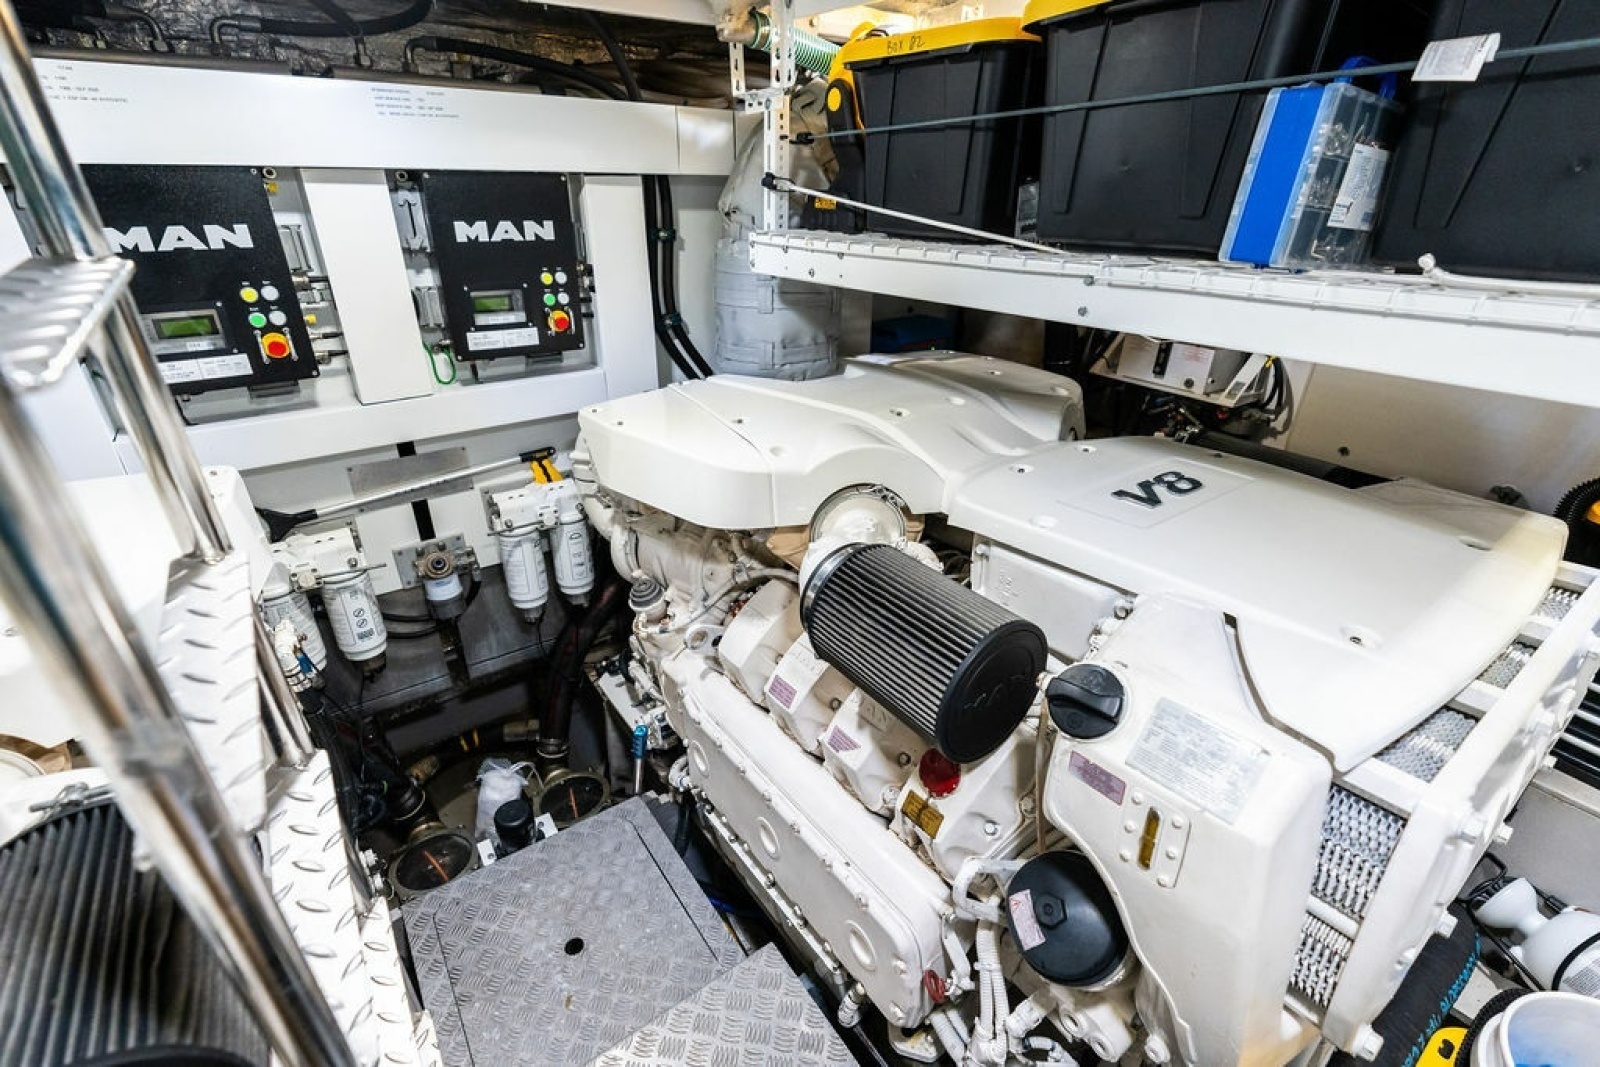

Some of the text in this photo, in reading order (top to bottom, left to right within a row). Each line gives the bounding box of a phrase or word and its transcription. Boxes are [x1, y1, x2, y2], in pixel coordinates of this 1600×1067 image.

[887, 40, 903, 54] BOX
[103, 223, 254, 253] MAN
[453, 220, 556, 243] MAN
[1111, 471, 1203, 508] V8
